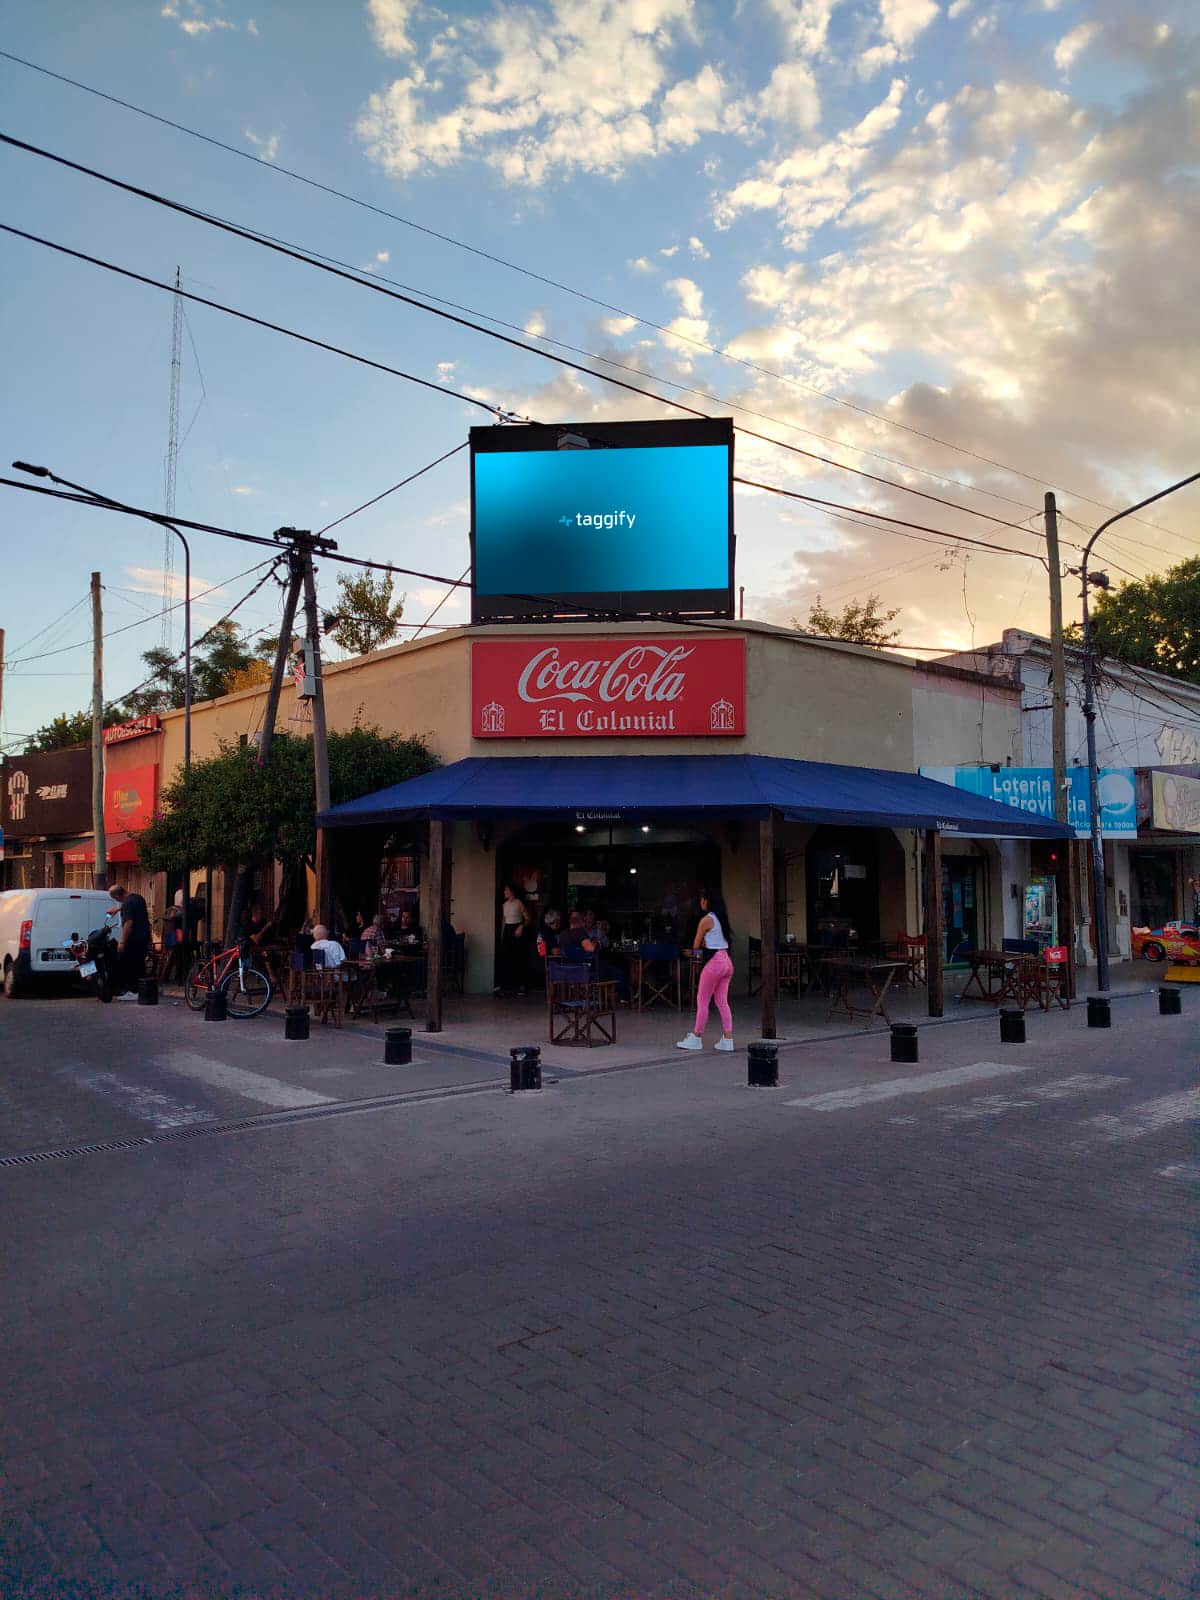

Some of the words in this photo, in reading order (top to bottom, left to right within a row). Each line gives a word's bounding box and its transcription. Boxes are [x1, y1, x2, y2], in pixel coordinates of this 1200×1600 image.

[576, 510, 636, 529] taggify
[517, 645, 697, 702] Coca-Cola
[538, 709, 565, 731] El
[576, 708, 676, 731] Colonial
[993, 775, 1051, 793] Lotería
